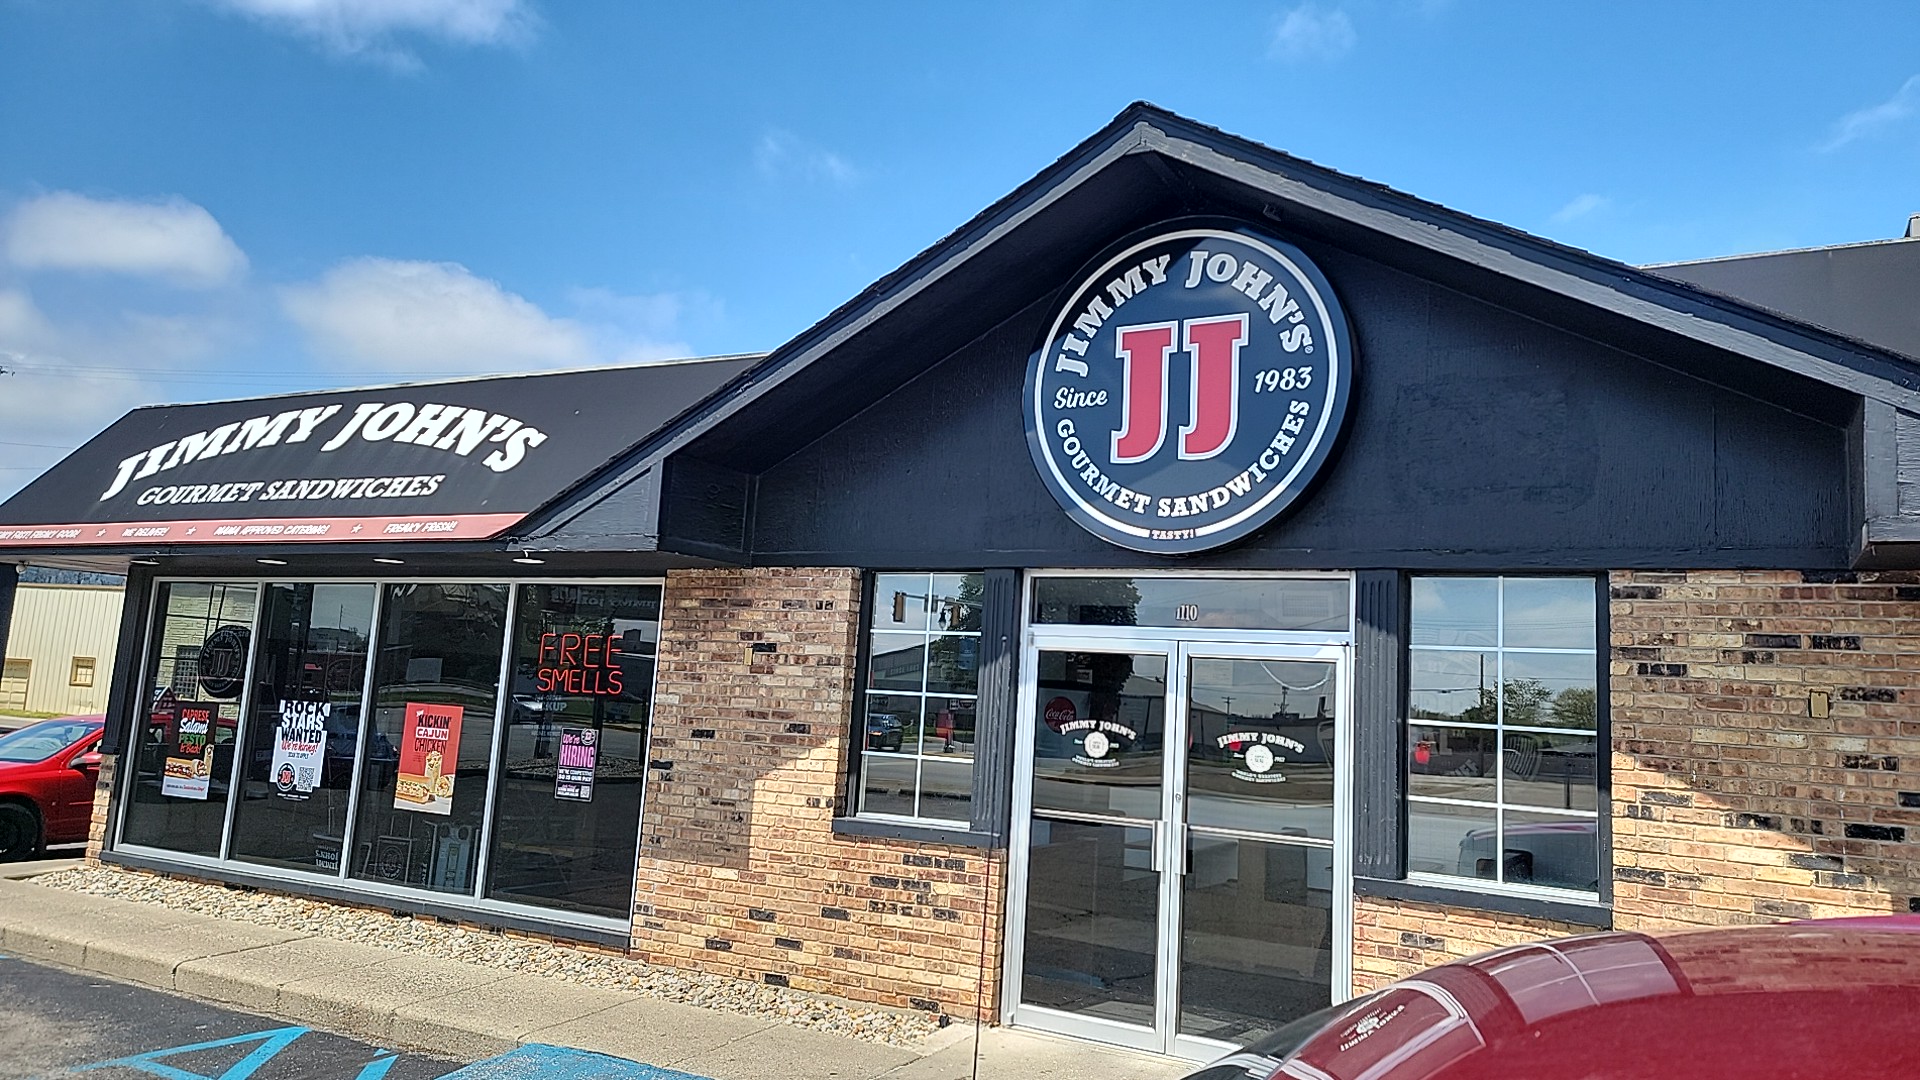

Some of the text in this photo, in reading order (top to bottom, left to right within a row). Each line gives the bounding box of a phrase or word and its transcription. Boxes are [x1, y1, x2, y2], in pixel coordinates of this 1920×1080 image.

[1055, 251, 1312, 377] JIMMY JOHN'S
[1110, 312, 1249, 464] JJ
[1254, 366, 1313, 392] 1983
[1054, 387, 1108, 409] Since
[100, 402, 548, 501] JIMMY JOHN'S
[1057, 400, 1309, 517] GOURMET SANDWICHES
[136, 474, 446, 506] GOURMET SANDWICHES
[382, 522, 424, 534] FREAKY
[1151, 529, 1194, 540] TASTY!
[1175, 604, 1198, 621] 1110
[538, 633, 624, 668] FREE
[536, 668, 623, 695] SMELLS
[284, 700, 326, 715] ROCK
[179, 717, 210, 734] Salami
[281, 712, 325, 731] STARS
[417, 714, 452, 729] KICKIN'
[1060, 720, 1137, 740] JIMMY JOHN'S
[178, 733, 207, 746] PESTO
[281, 727, 322, 744] WANTED
[416, 728, 448, 739] CAJUN
[1217, 732, 1305, 754] JIMMY JOHN'S
[414, 737, 447, 754] CHICKEN
[559, 744, 594, 768] HIRING
